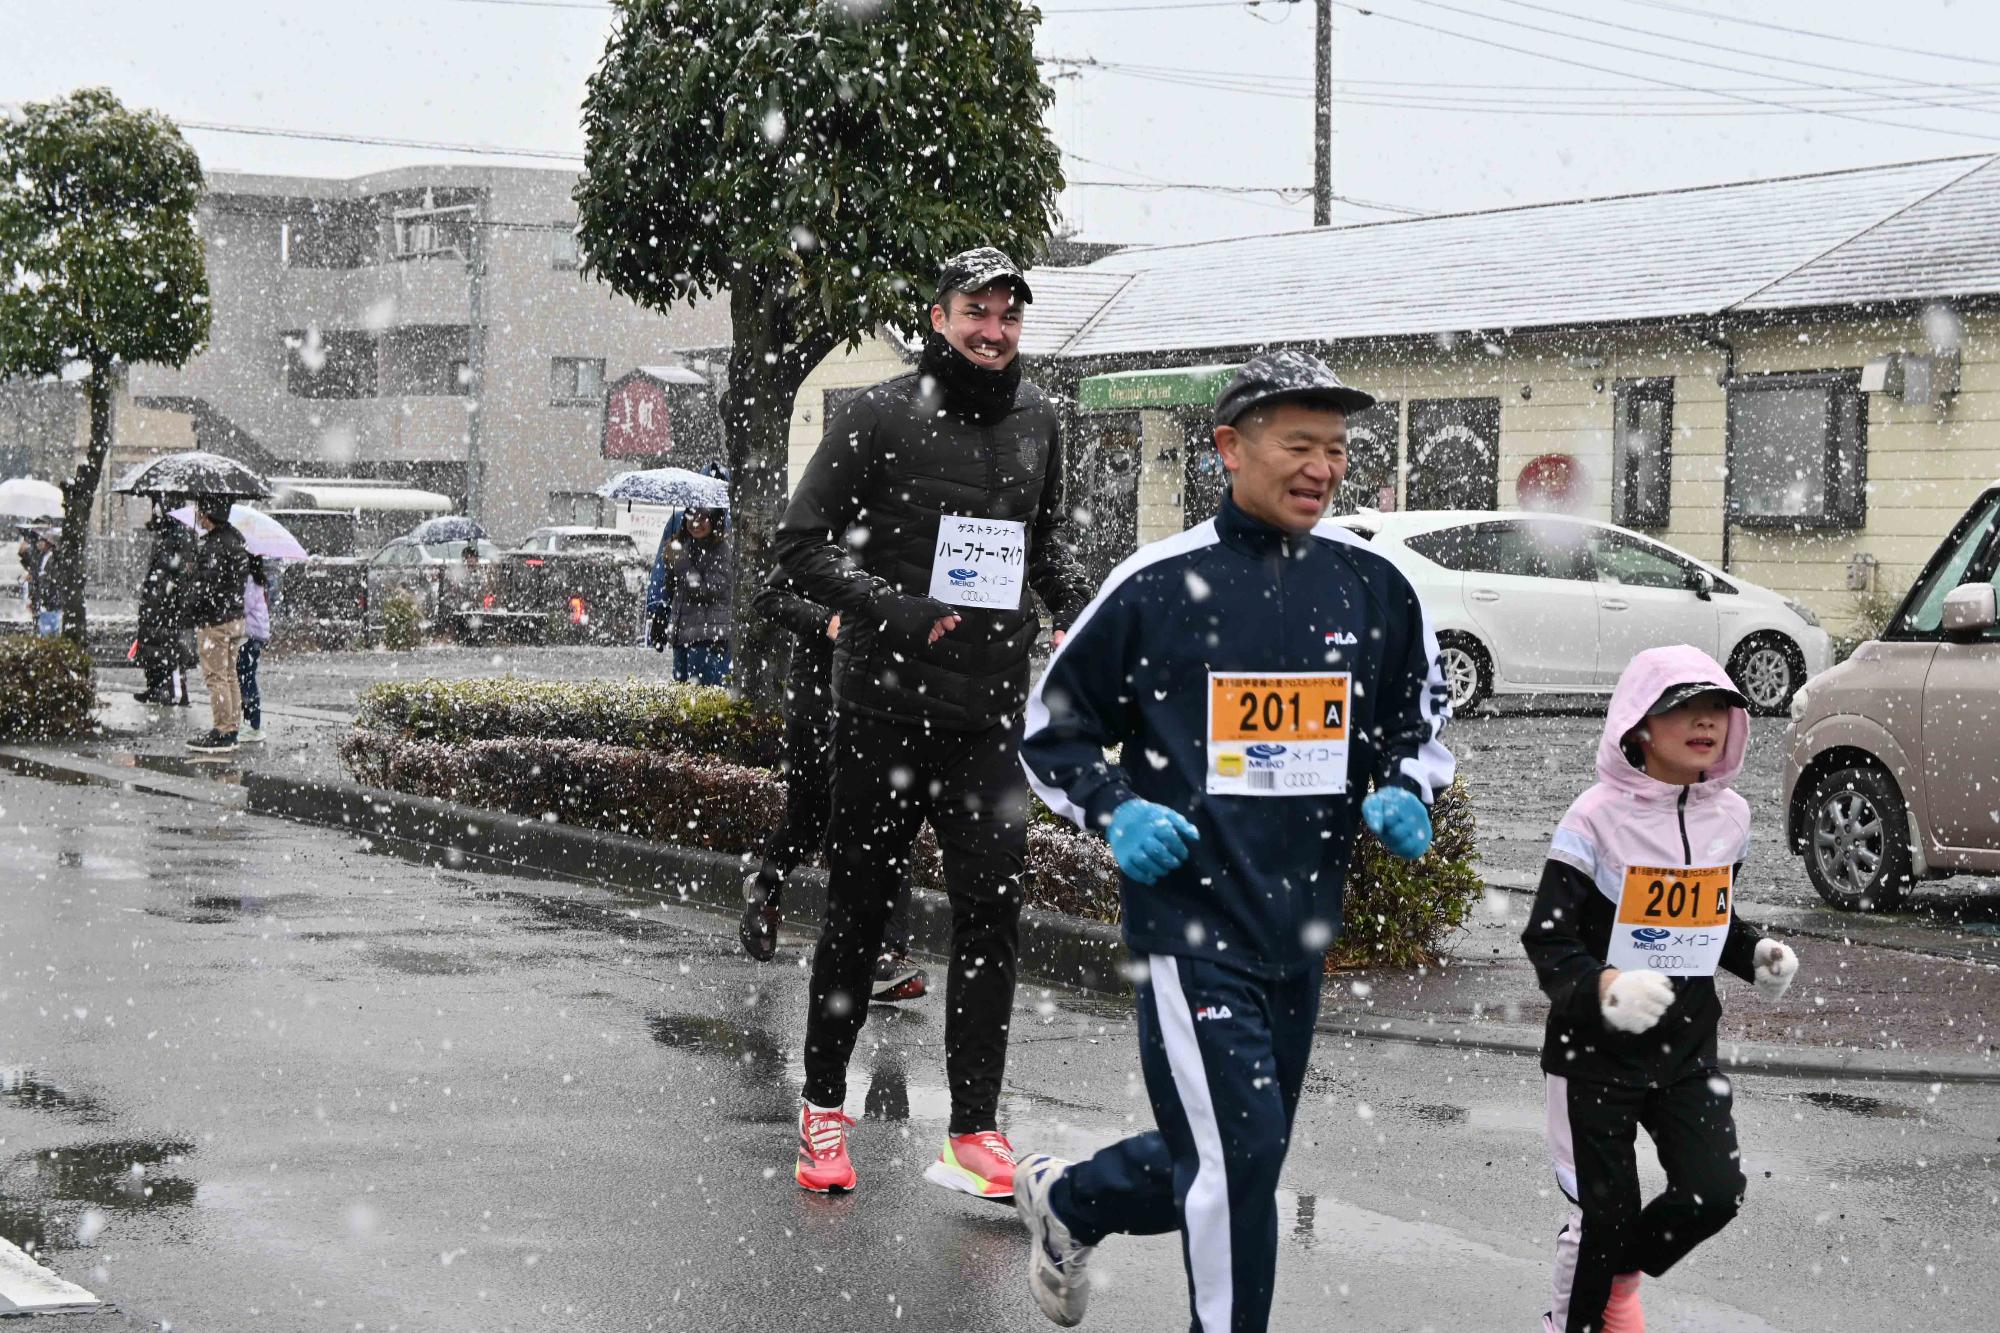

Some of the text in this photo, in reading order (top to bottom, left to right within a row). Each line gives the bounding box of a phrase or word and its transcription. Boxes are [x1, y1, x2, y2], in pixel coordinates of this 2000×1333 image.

[958, 524, 1015, 537] ゲストランナー
[939, 542, 1022, 566] ハーフナー・マイク
[950, 580, 975, 588] MEIKO
[980, 576, 1015, 586] メイコー
[1325, 632, 1358, 645] FILA
[1240, 692, 1300, 731] 201
[1325, 705, 1339, 725] A
[1292, 749, 1343, 762] メイコー
[1645, 880, 1700, 918] 201
[1717, 893, 1726, 911] A
[1633, 942, 1666, 951] MEIKO
[1672, 934, 1718, 947] メイコー
[1196, 1005, 1232, 1021] FILA
